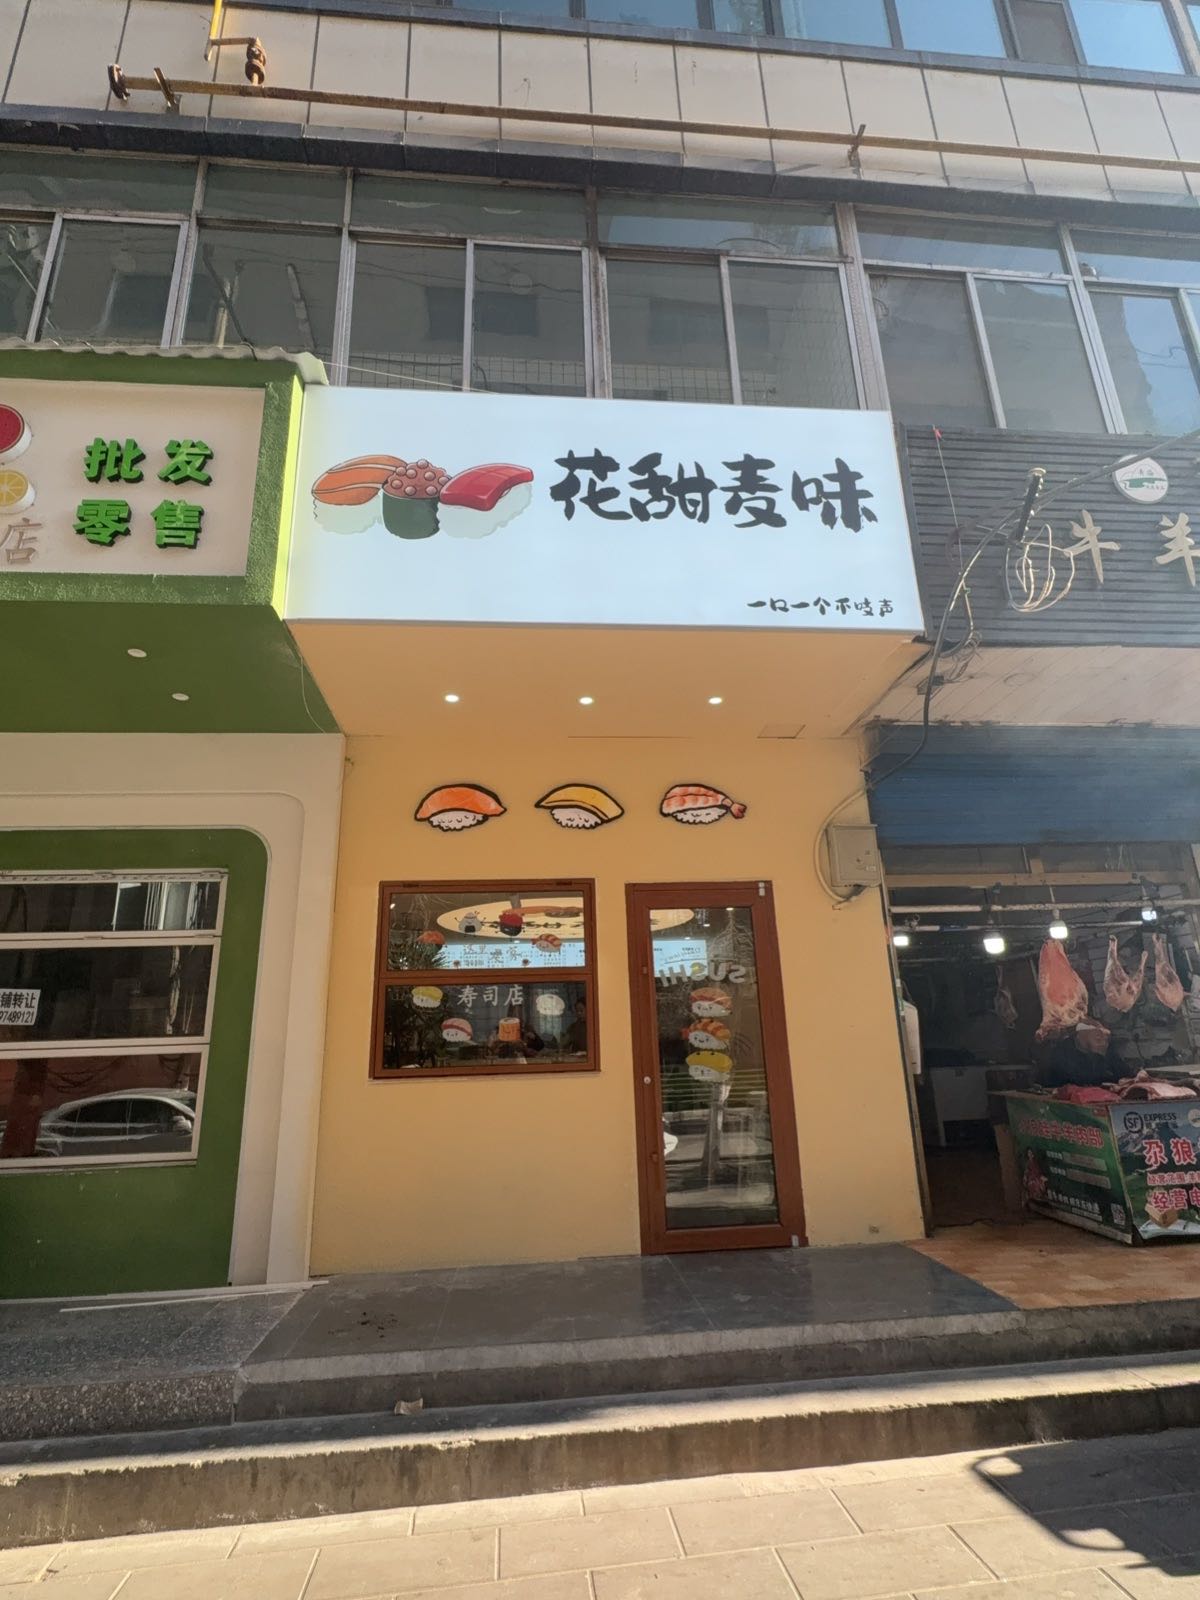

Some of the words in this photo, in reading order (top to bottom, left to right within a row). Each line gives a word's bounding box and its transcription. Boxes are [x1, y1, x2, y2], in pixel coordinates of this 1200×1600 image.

[83, 437, 214, 486] 批发
[549, 448, 878, 533] 花甜麦味
[73, 499, 205, 549] 零售
[0, 517, 42, 565] 店
[746, 596, 894, 618] 一口一个不吱声
[0, 991, 36, 1009] 铺转让
[456, 983, 525, 1008] 寿司店
[1143, 1112, 1178, 1121] EXPRESS
[1143, 1138, 1200, 1166] 尕狼
